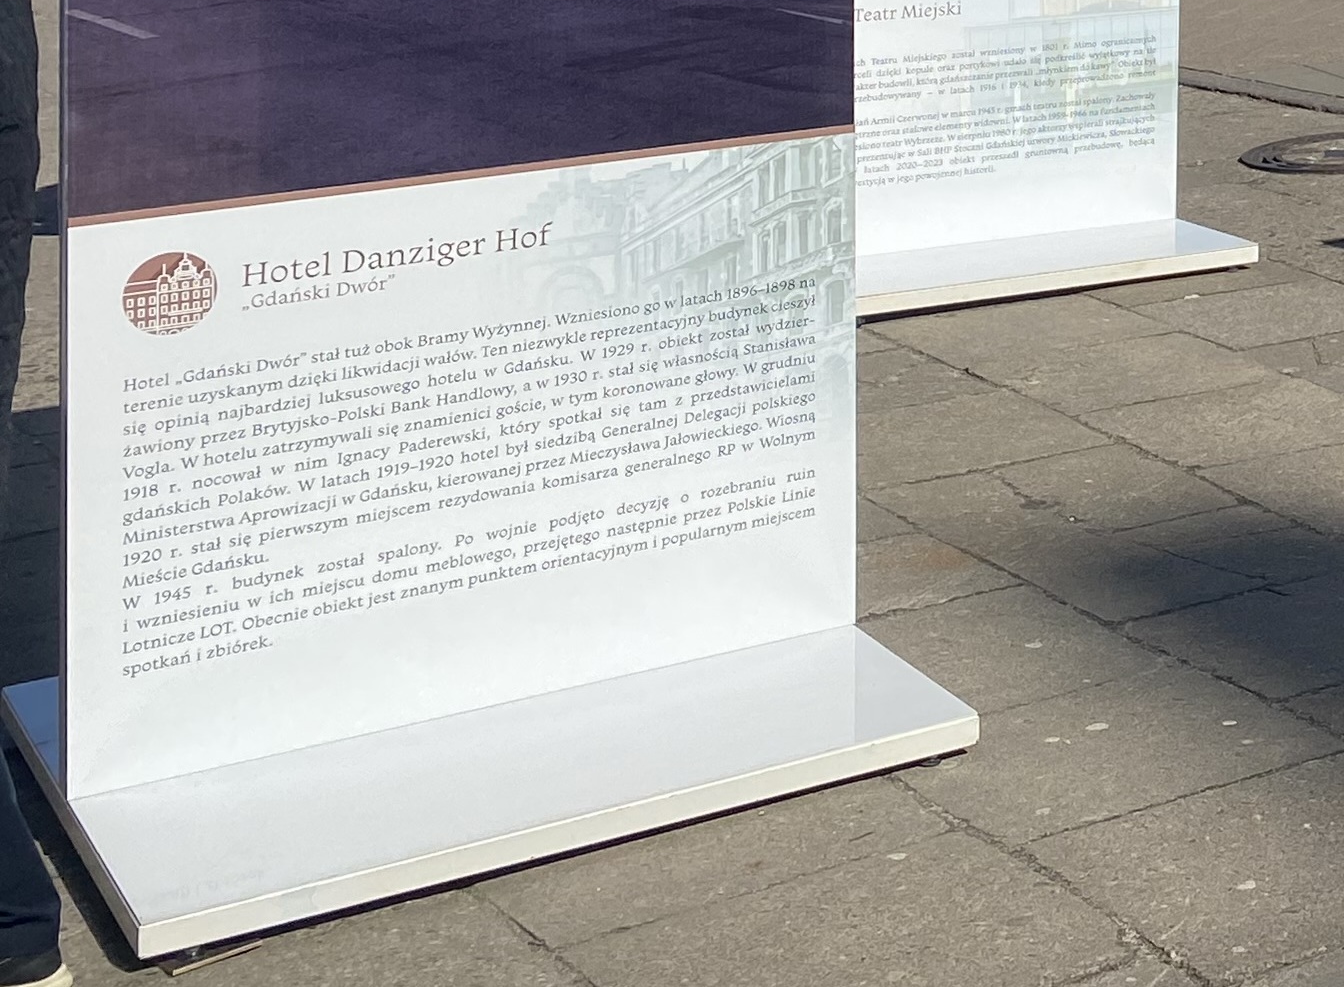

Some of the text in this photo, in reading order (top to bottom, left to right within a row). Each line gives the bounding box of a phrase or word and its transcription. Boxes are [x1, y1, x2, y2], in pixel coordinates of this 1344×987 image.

[855, 1, 961, 23] Teatr Miejski
[242, 221, 553, 288] Hotel Danziger Hof
[122, 372, 170, 393] Hotel
[310, 346, 341, 364] stał
[344, 343, 371, 359] tuż
[374, 336, 414, 354] obok
[416, 330, 470, 348] Bramy
[471, 315, 551, 341] Wyżynnej.
[553, 304, 640, 326] Wzniesiono
[643, 301, 661, 316] go
[663, 298, 678, 310] w
[679, 289, 723, 308] latach
[798, 278, 816, 291] na
[122, 316, 816, 437] się opinią najbardziej luksusowego hotelu w Gdańsku. W 1929 r. obiekt został wydzier-
[122, 335, 817, 458] żawiony przez Brytyjsko-Polski Bank Handlowy, a w 1930 r. stał się własnością Stanisława
[123, 293, 816, 415] terenie uzyskanym dzięki likwidacji wałów. Ten niezwykle reprezentacyjny budynek cieszył
[121, 350, 816, 480] Vogla. W hotelu zatrzymywali się znamienici goście, w tym koronowane głowy. W grudniu
[122, 495, 211, 527] gdańskich
[217, 484, 292, 507] Polaków.
[296, 477, 317, 493] W
[320, 468, 371, 489] latach
[459, 444, 500, 465] hotel
[505, 439, 529, 459] był
[534, 429, 598, 451] siedzibą
[601, 413, 678, 439] Generalnej
[683, 401, 747, 425] Delegacji
[751, 392, 816, 416] polskiego
[123, 370, 816, 502] 1918 r. nocował w nim Ignacy Paderewski, który spotkał się tam z przedstawicielami
[122, 410, 816, 546] Ministerstwa Aprowizacji w Gdańsku, kierowanej przez Mieczysława Jałowieckiego. Wiosną
